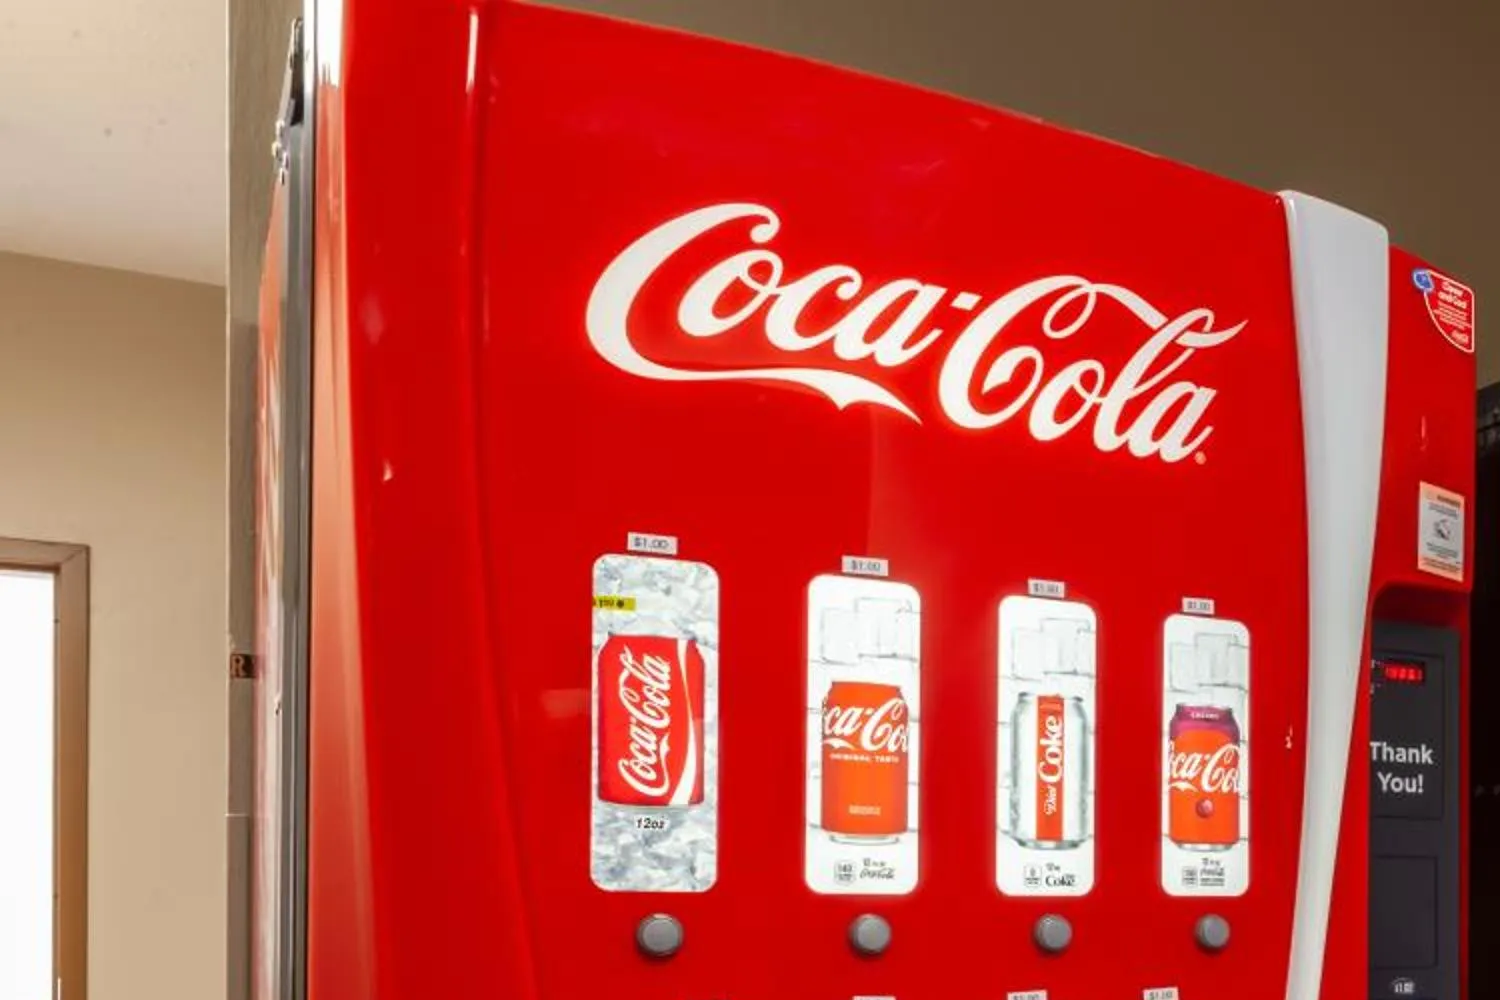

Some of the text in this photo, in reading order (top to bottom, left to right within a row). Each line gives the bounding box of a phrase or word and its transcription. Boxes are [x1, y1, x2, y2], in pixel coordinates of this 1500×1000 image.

[586, 203, 1248, 463] Coca-Cola
[618, 644, 671, 797] Coca-Cola
[1039, 714, 1062, 784] Coke
[1369, 741, 1434, 765] Thank
[1377, 771, 1424, 793] You!
[636, 817, 666, 830] 12oz
